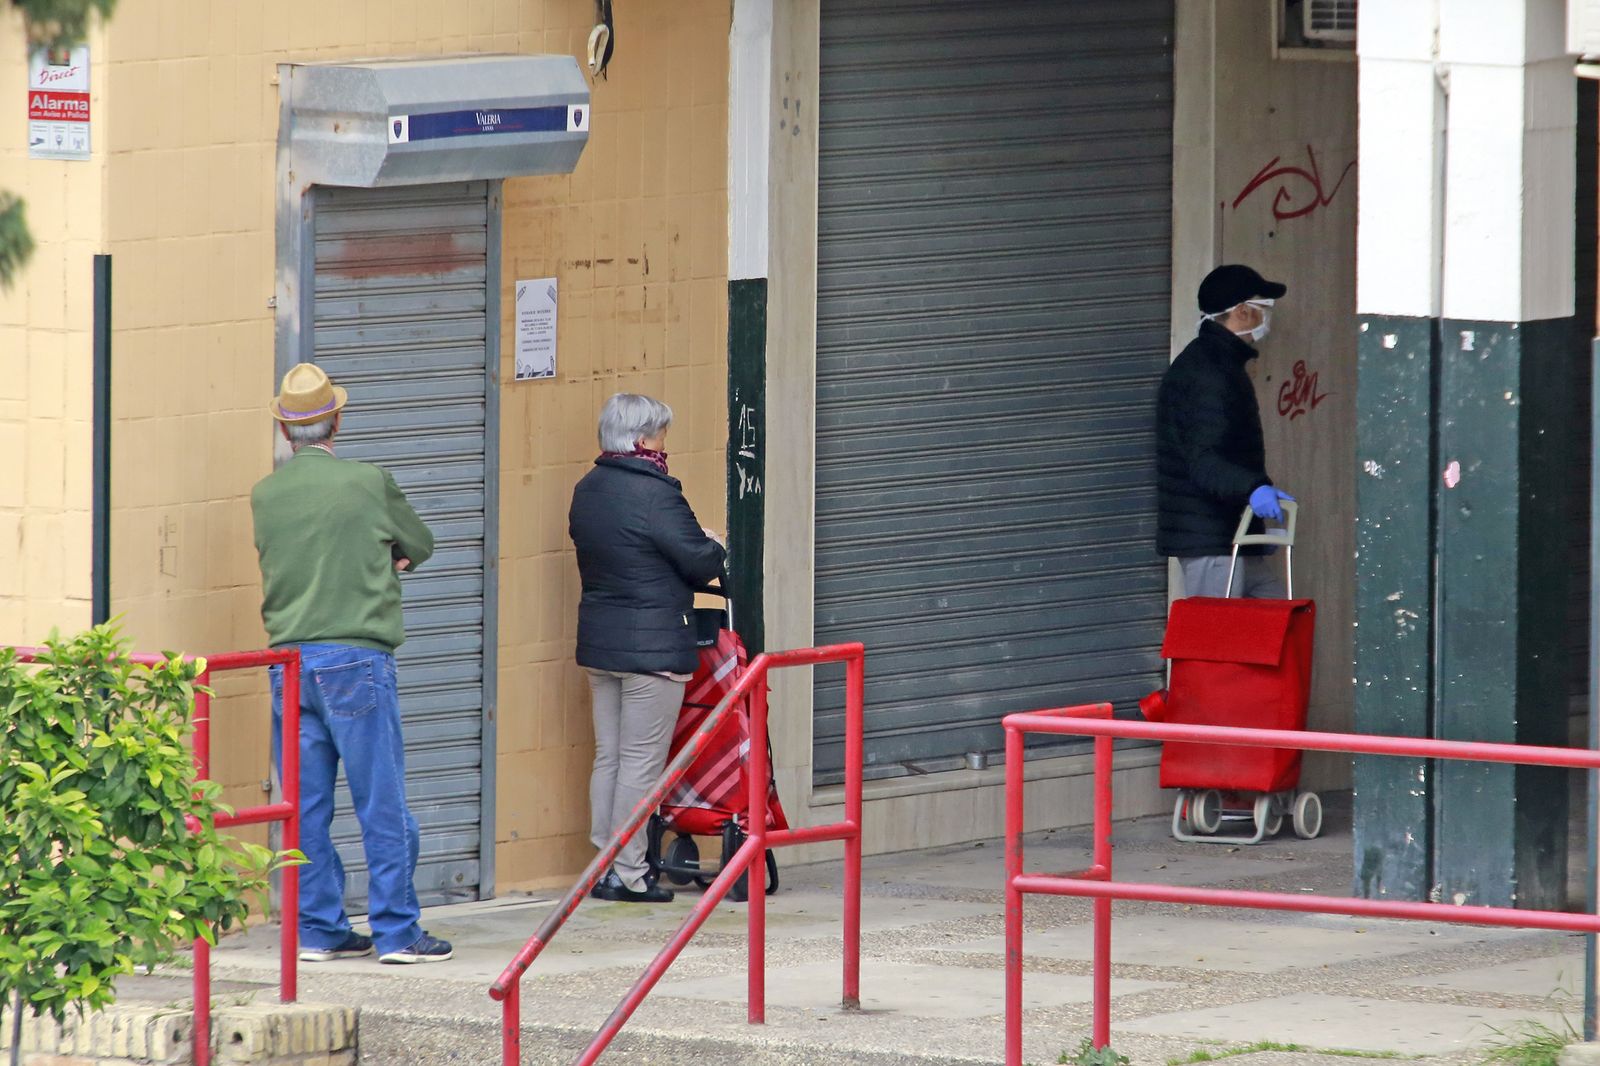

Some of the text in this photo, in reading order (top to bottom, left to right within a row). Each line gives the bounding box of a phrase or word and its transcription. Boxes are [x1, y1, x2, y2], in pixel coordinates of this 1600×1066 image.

[39, 66, 80, 85] Direct
[31, 94, 89, 111] Alarma
[42, 110, 61, 118] Aviso
[475, 112, 501, 125] VALERIA
